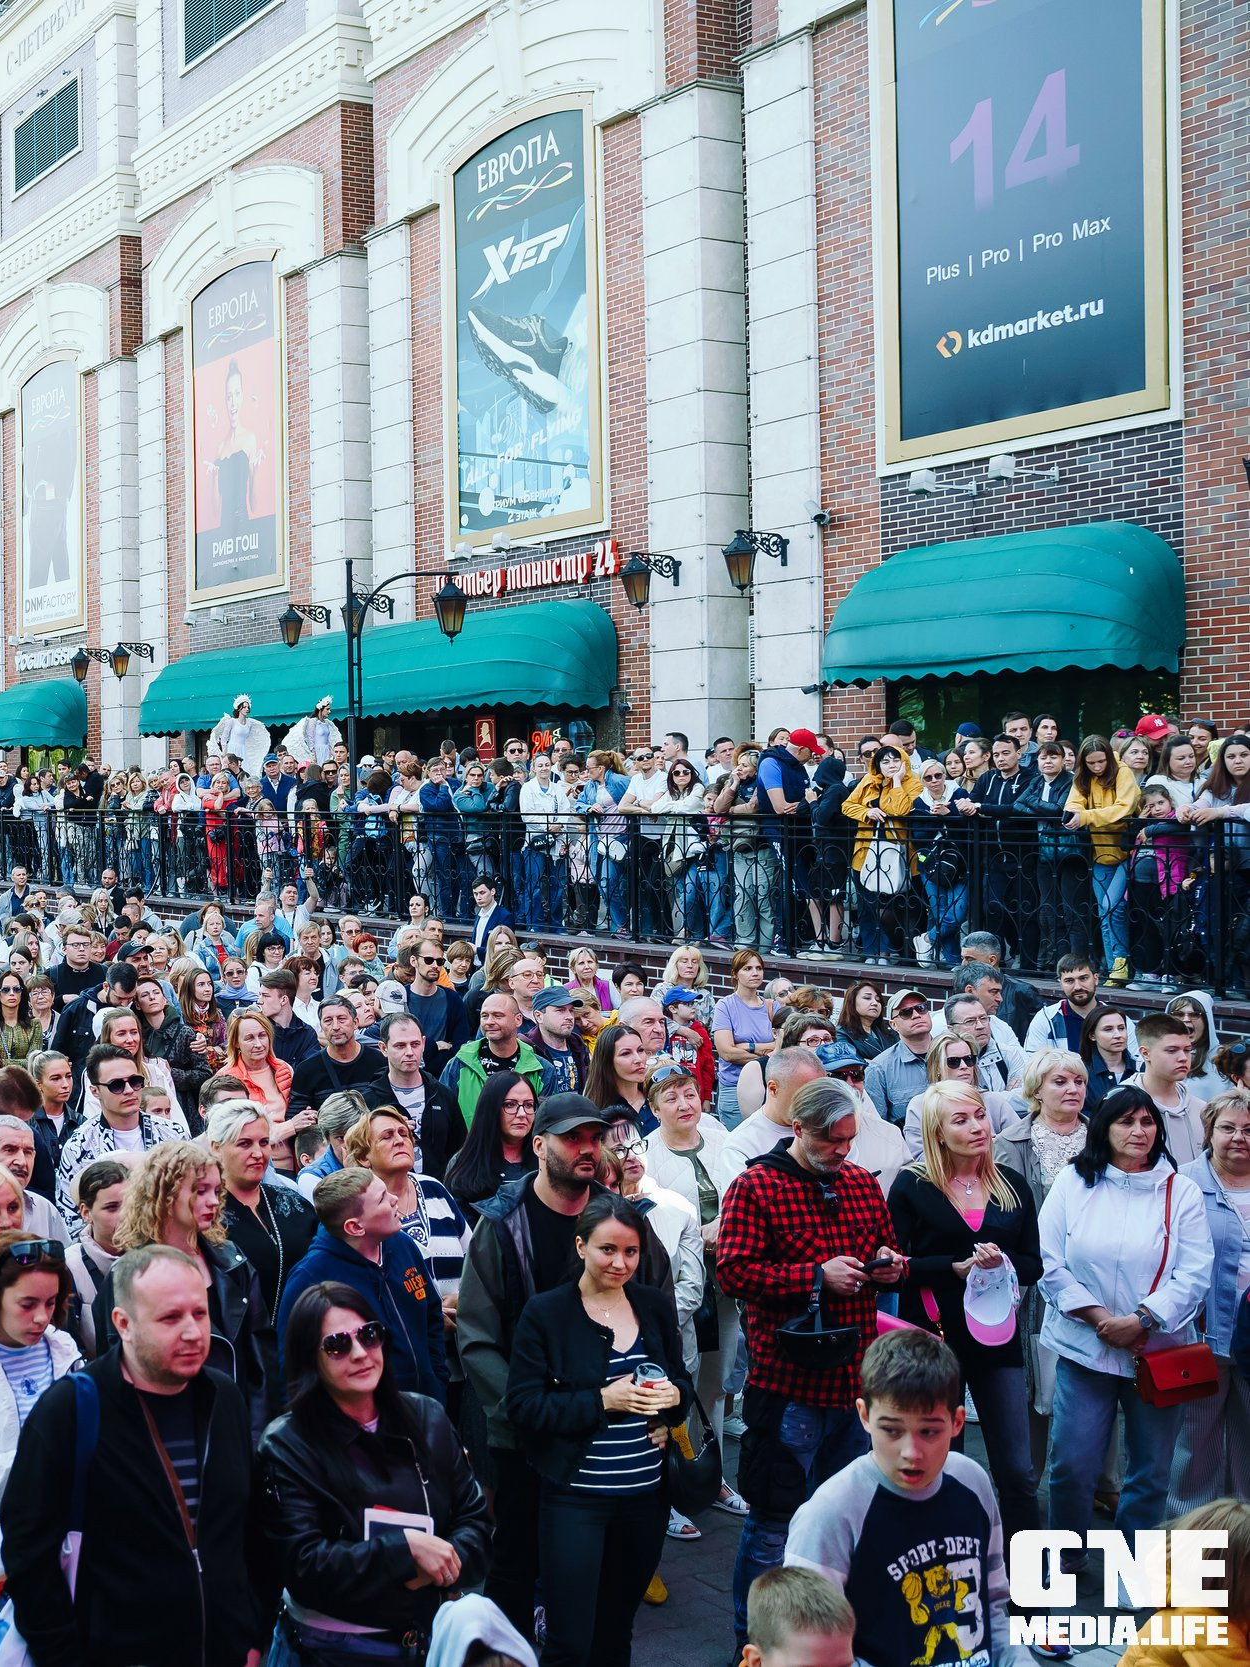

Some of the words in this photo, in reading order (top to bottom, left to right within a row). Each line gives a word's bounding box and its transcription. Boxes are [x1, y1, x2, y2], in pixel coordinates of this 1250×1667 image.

[477, 129, 560, 193] ЕВРОПА
[950, 68, 1080, 213] 14
[926, 260, 960, 285] Plus
[981, 248, 1010, 269] Pro
[1032, 230, 1063, 254] Pro
[1072, 216, 1111, 241] Max
[208, 289, 259, 329] ЕВРОПА
[967, 299, 1104, 349] kdmarket.ru
[31, 386, 66, 417] ЕВРОПА
[212, 538, 234, 558] РИВ
[235, 532, 259, 553] ГОШ
[594, 540, 620, 577] 24
